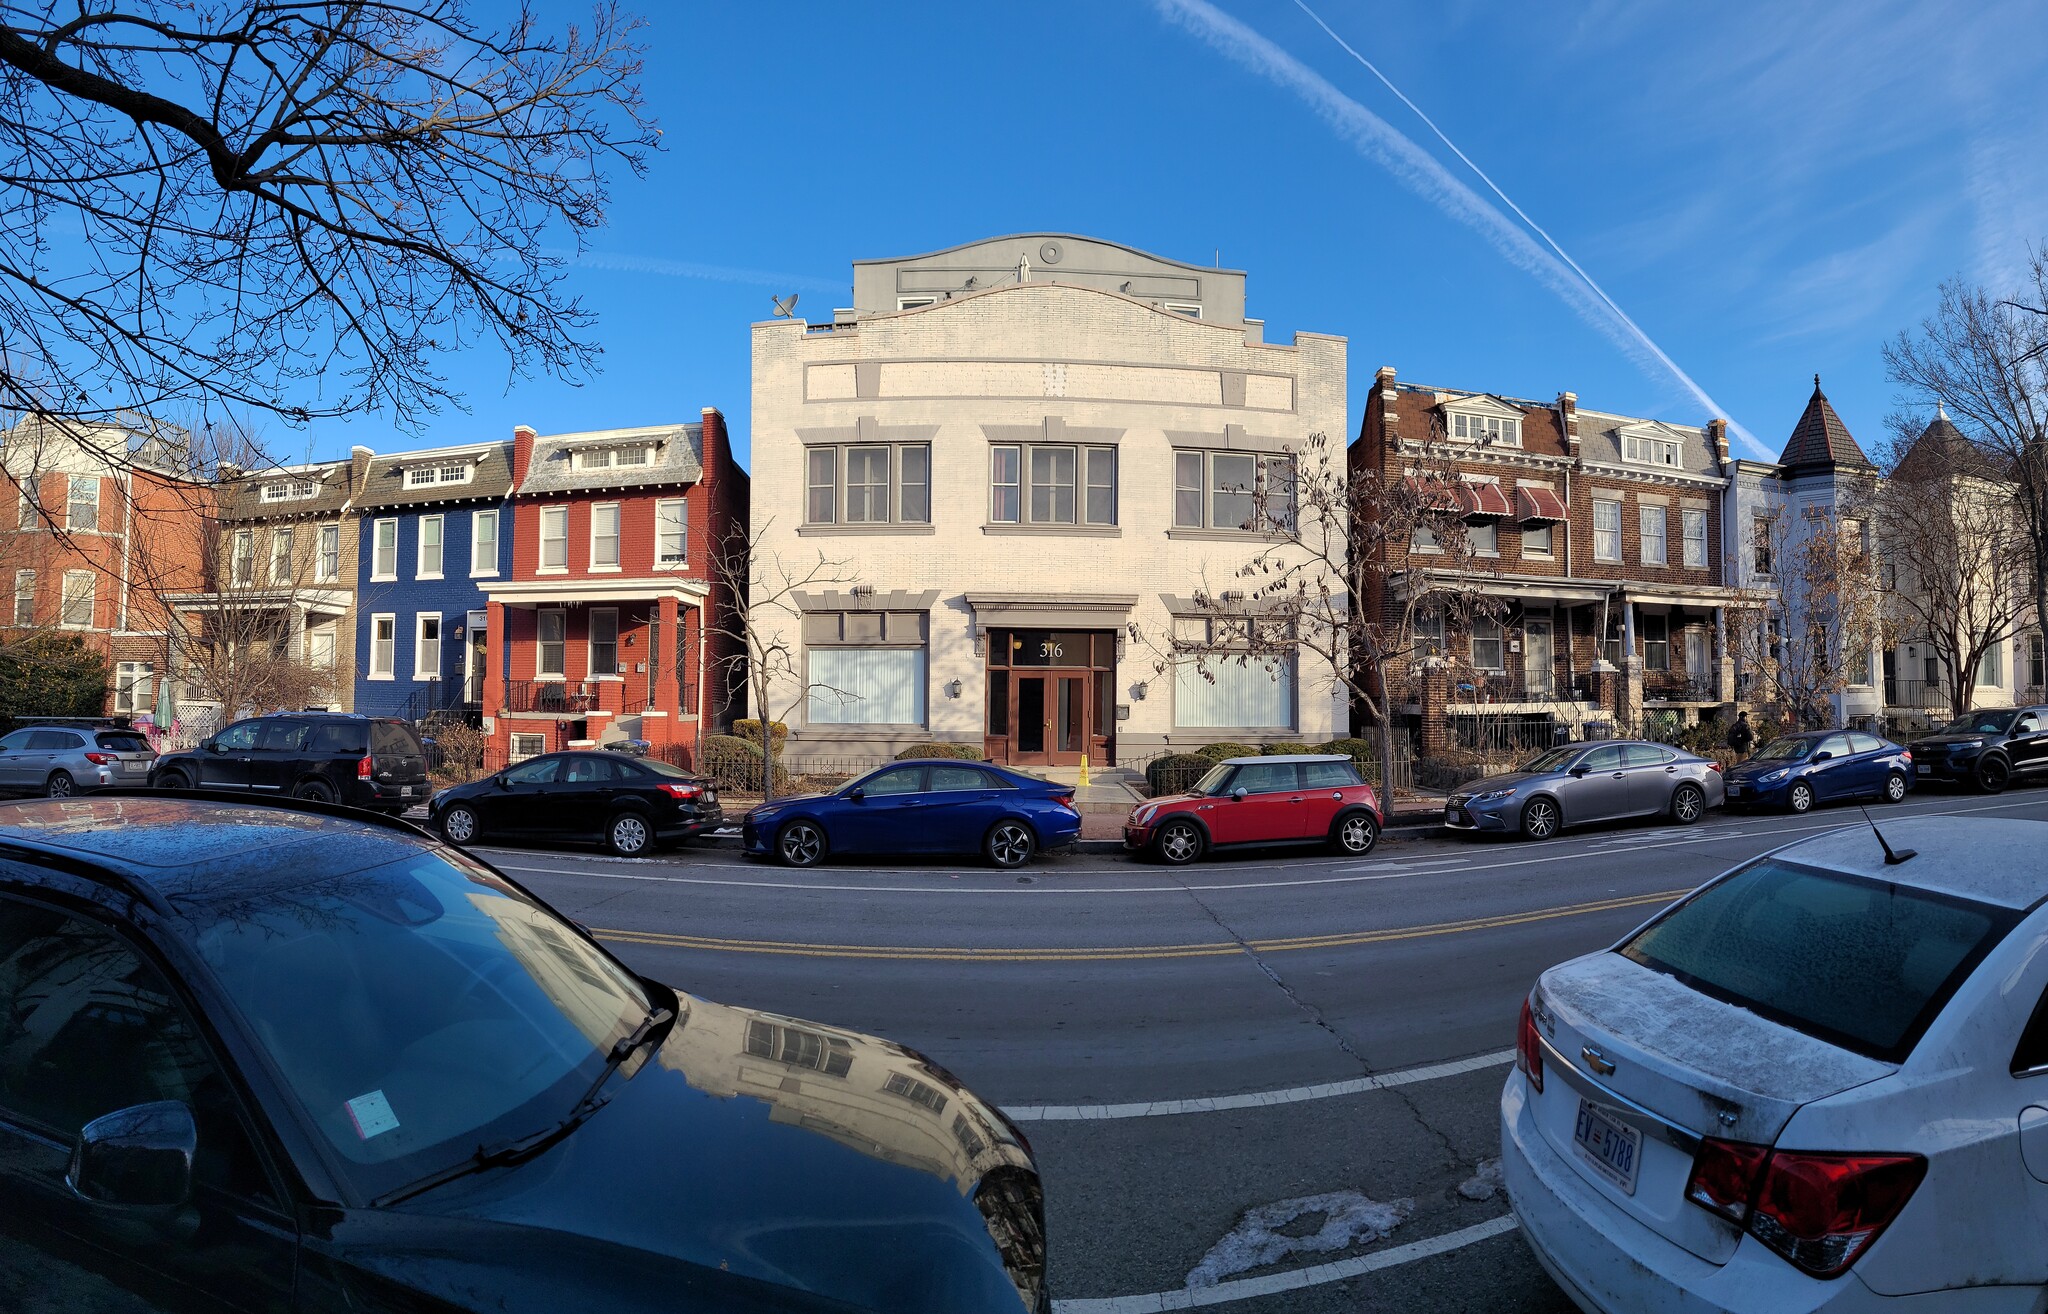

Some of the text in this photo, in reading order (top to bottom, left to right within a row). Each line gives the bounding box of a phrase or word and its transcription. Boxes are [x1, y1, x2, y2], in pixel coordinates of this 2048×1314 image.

[1039, 642, 1063, 658] 316
[1576, 1110, 1594, 1142] EV
[1603, 1129, 1633, 1172] 5788
